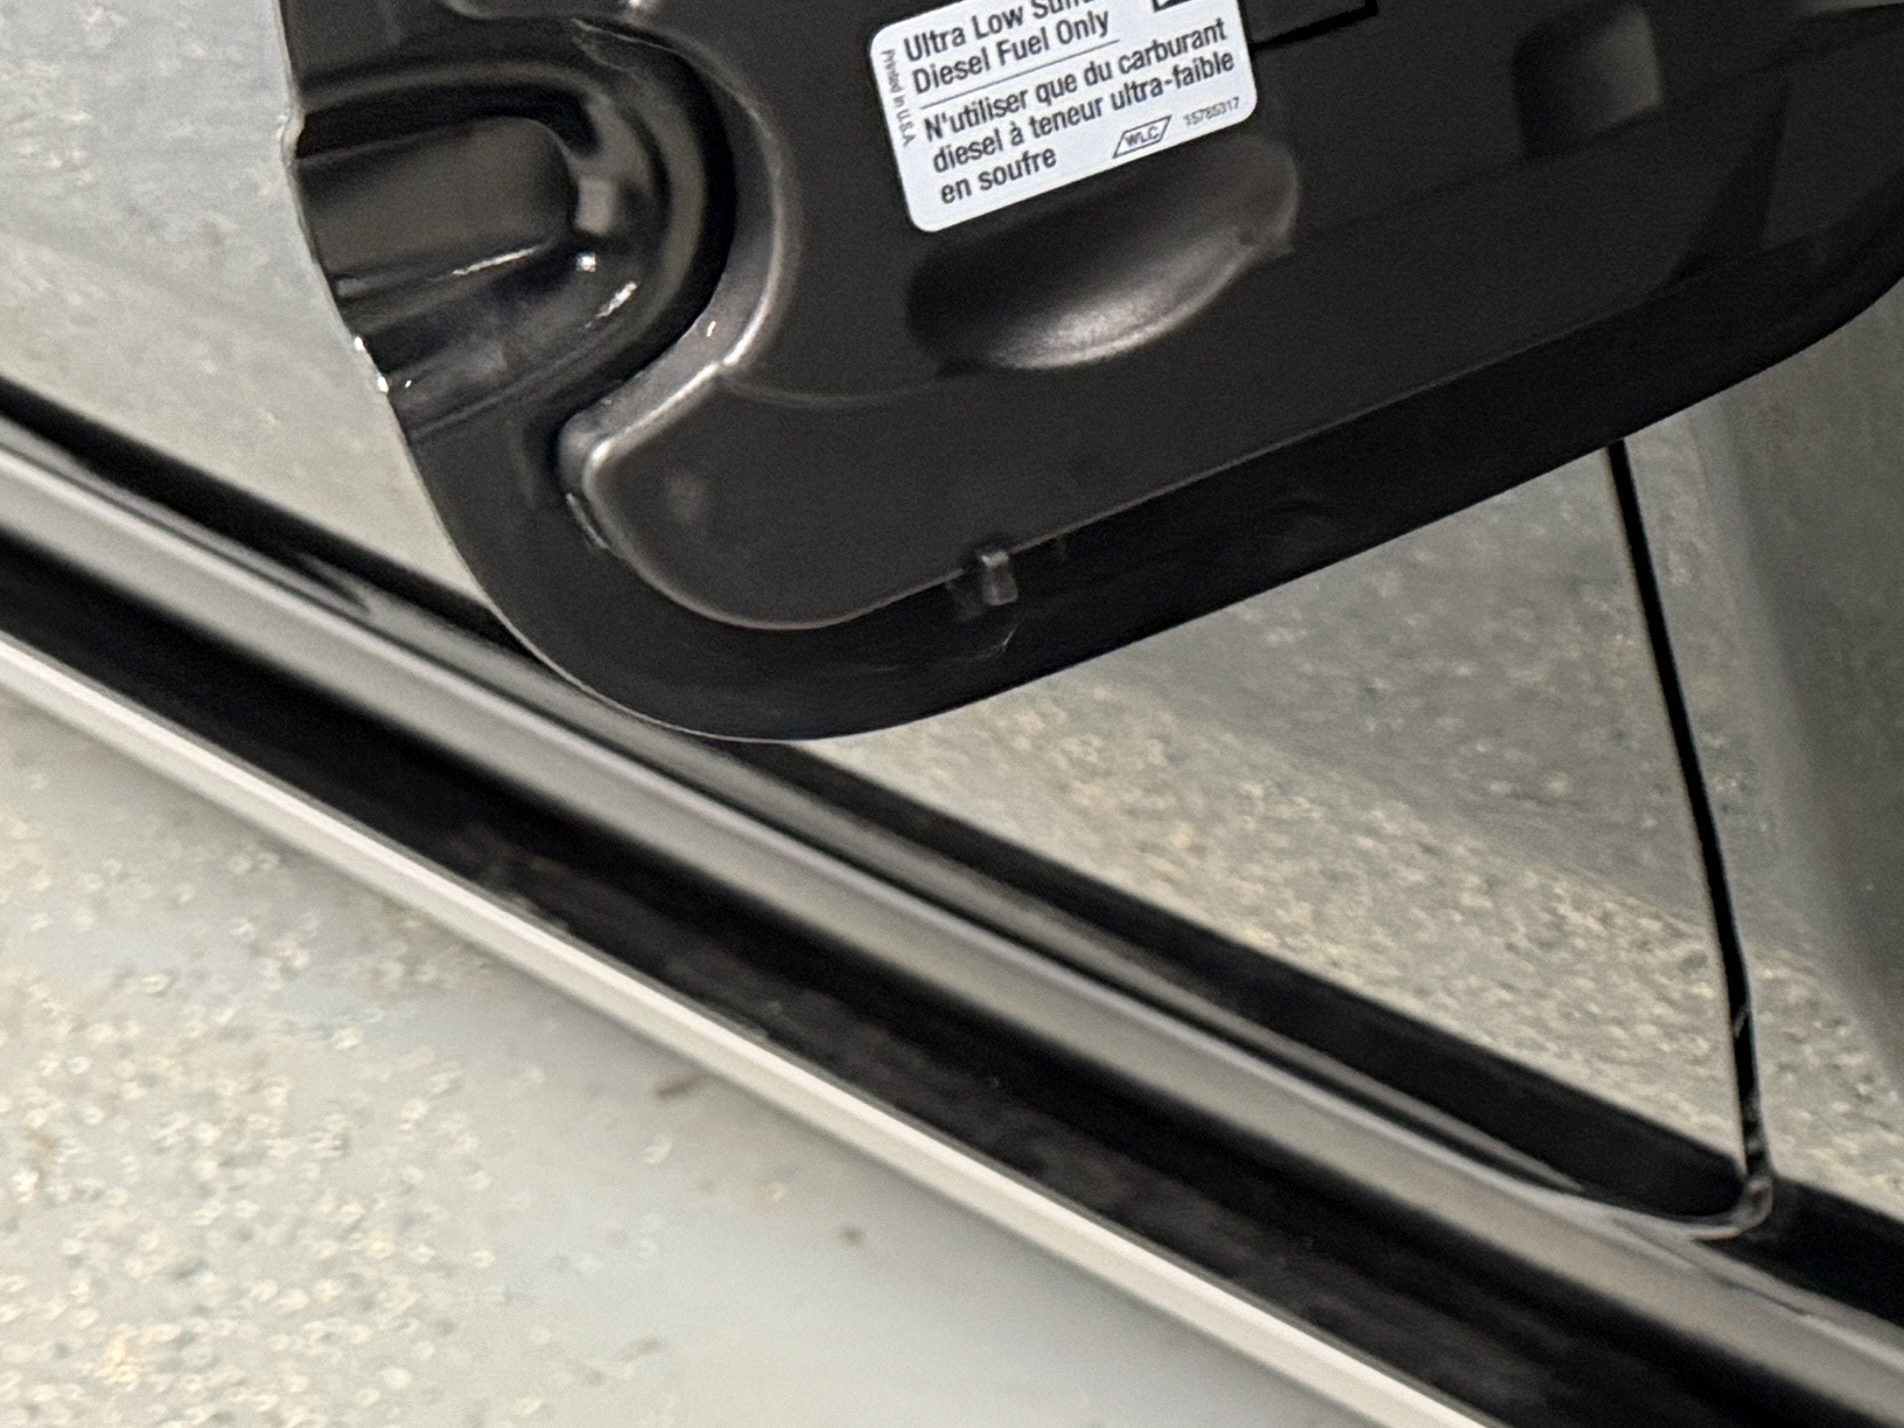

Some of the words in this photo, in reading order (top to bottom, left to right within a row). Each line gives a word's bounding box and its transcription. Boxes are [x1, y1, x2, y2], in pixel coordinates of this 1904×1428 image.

[903, 19, 967, 62] Ultra
[971, 1, 1024, 40] Low
[912, 40, 992, 94] Diesel
[997, 21, 1051, 66] Fuel
[1056, 5, 1109, 45] Only
[924, 89, 1028, 142] N'utiliser
[1035, 72, 1078, 106] que
[1084, 60, 1113, 87] du
[1117, 17, 1227, 74] carburant
[933, 127, 1004, 173] diesel
[1009, 120, 1025, 147] à
[1029, 96, 1104, 139] teneur
[1110, 51, 1234, 111] ultra-faible
[1125, 125, 1161, 147] WLC
[941, 177, 972, 205] en
[978, 147, 1057, 191] soufre
